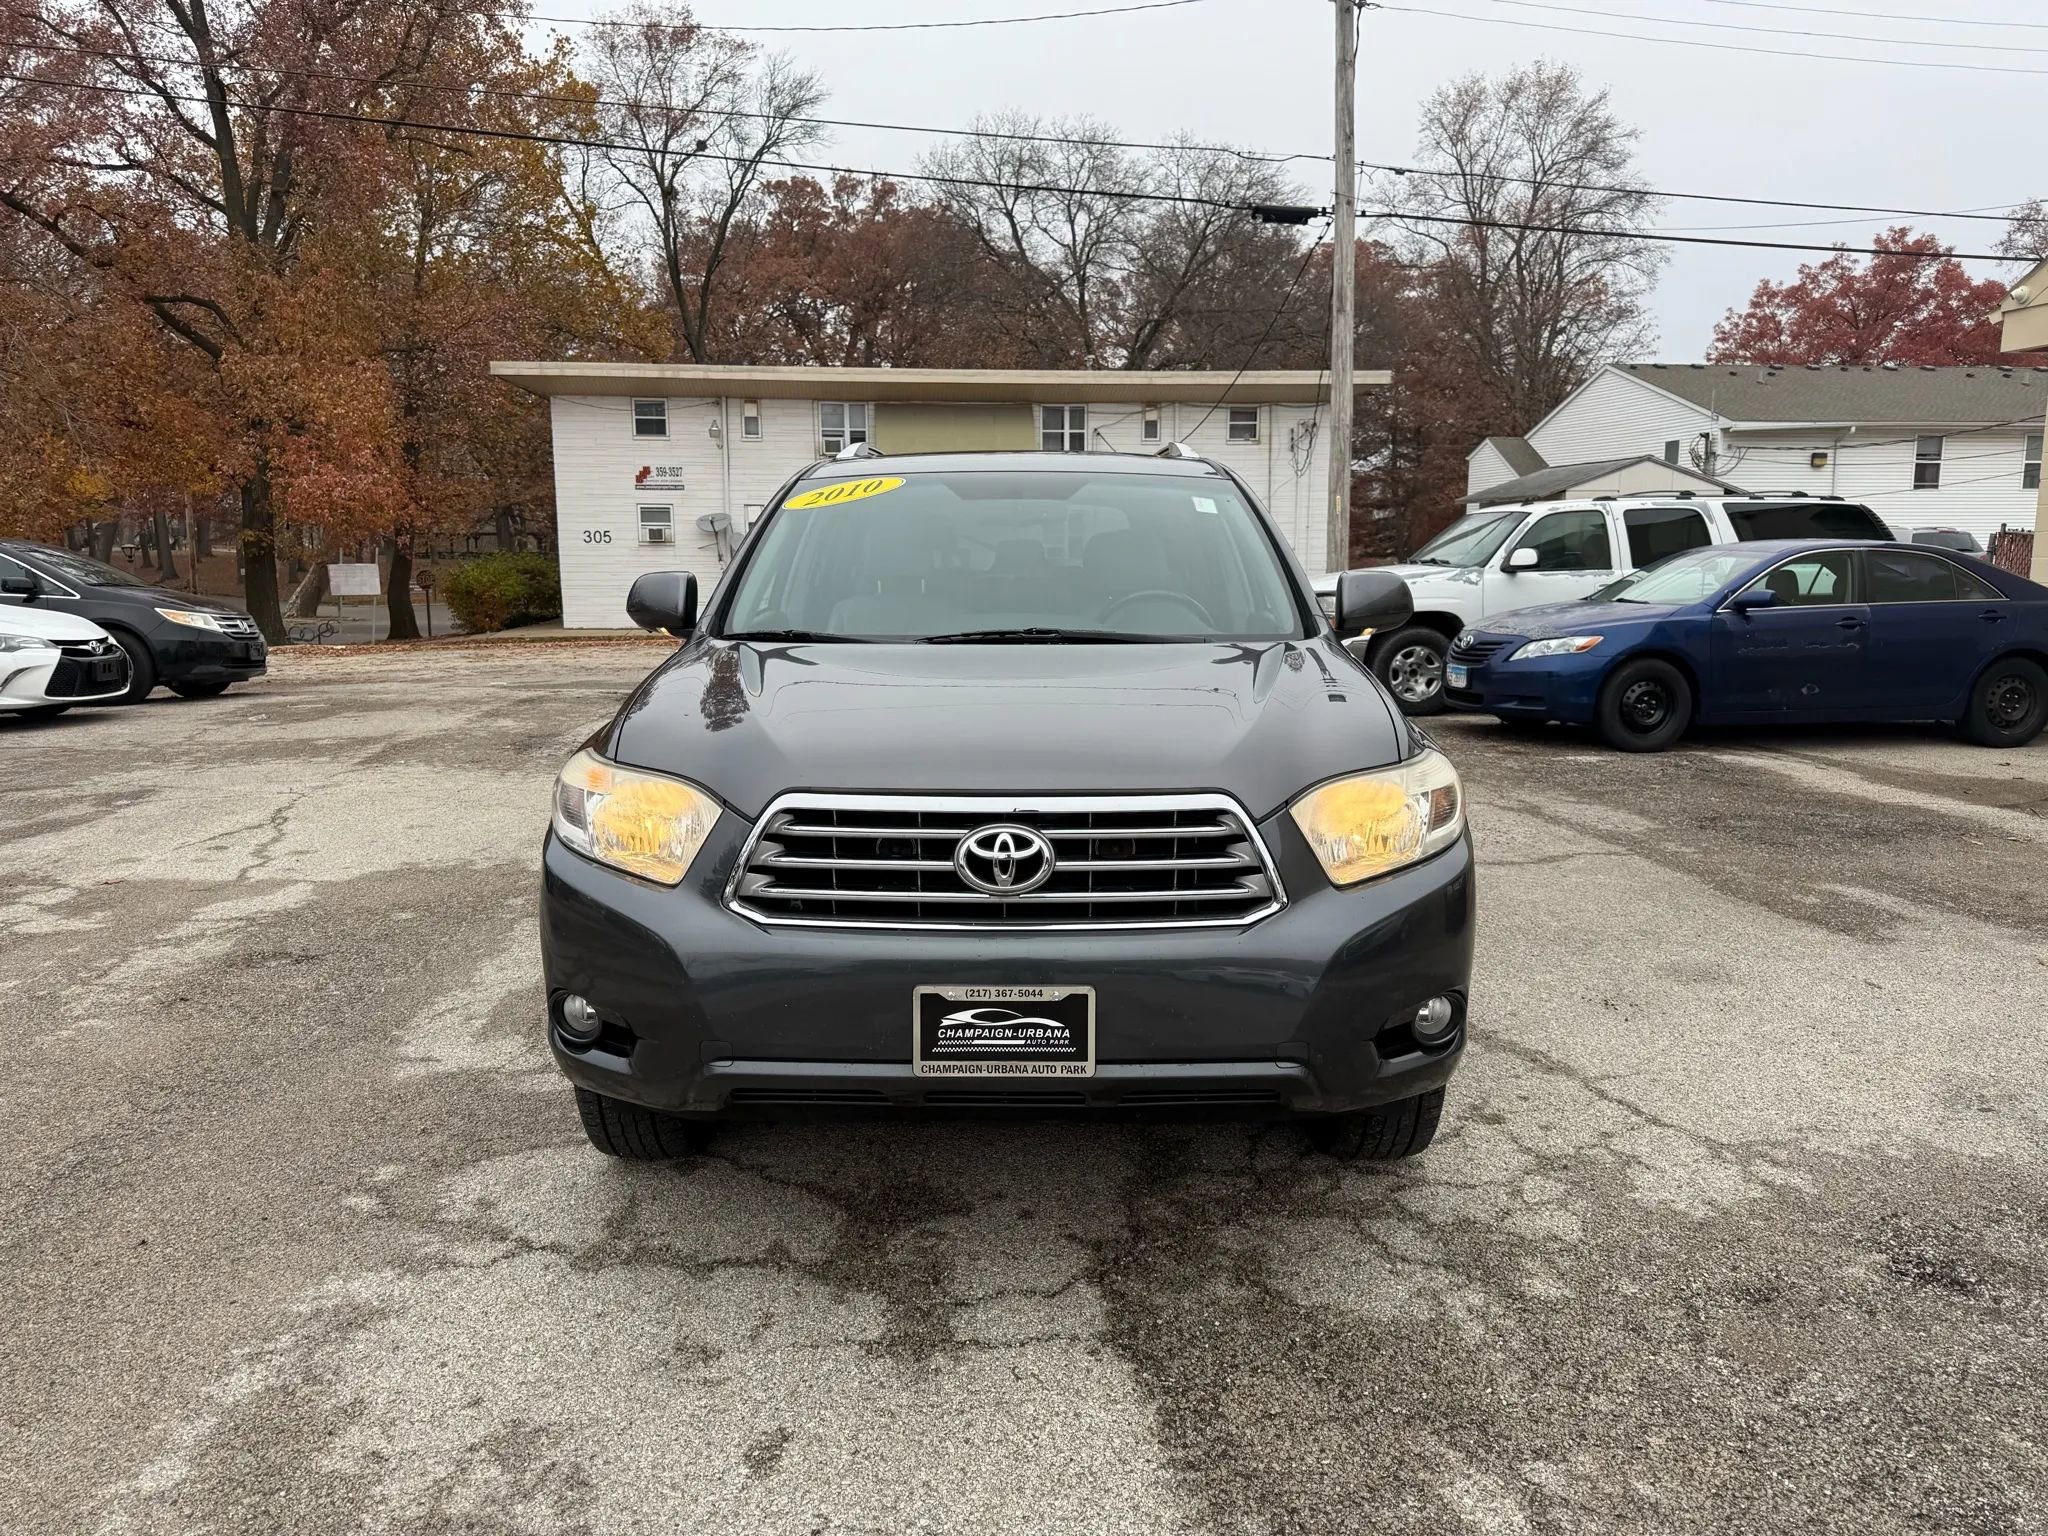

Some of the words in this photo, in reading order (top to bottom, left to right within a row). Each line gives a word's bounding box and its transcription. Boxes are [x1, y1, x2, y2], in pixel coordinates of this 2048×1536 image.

[655, 466, 683, 478] 359-3527
[802, 479, 884, 507] 2010
[583, 530, 612, 544] 305
[965, 988, 992, 999] (217)
[994, 988, 1044, 998] 367-5044
[937, 1028, 1071, 1038] CHAMPAIGN-URBANA
[921, 1064, 1029, 1075] CHAMPAIGN-URBANA
[1030, 1064, 1057, 1075] AUTO
[1060, 1064, 1087, 1075] PARK
